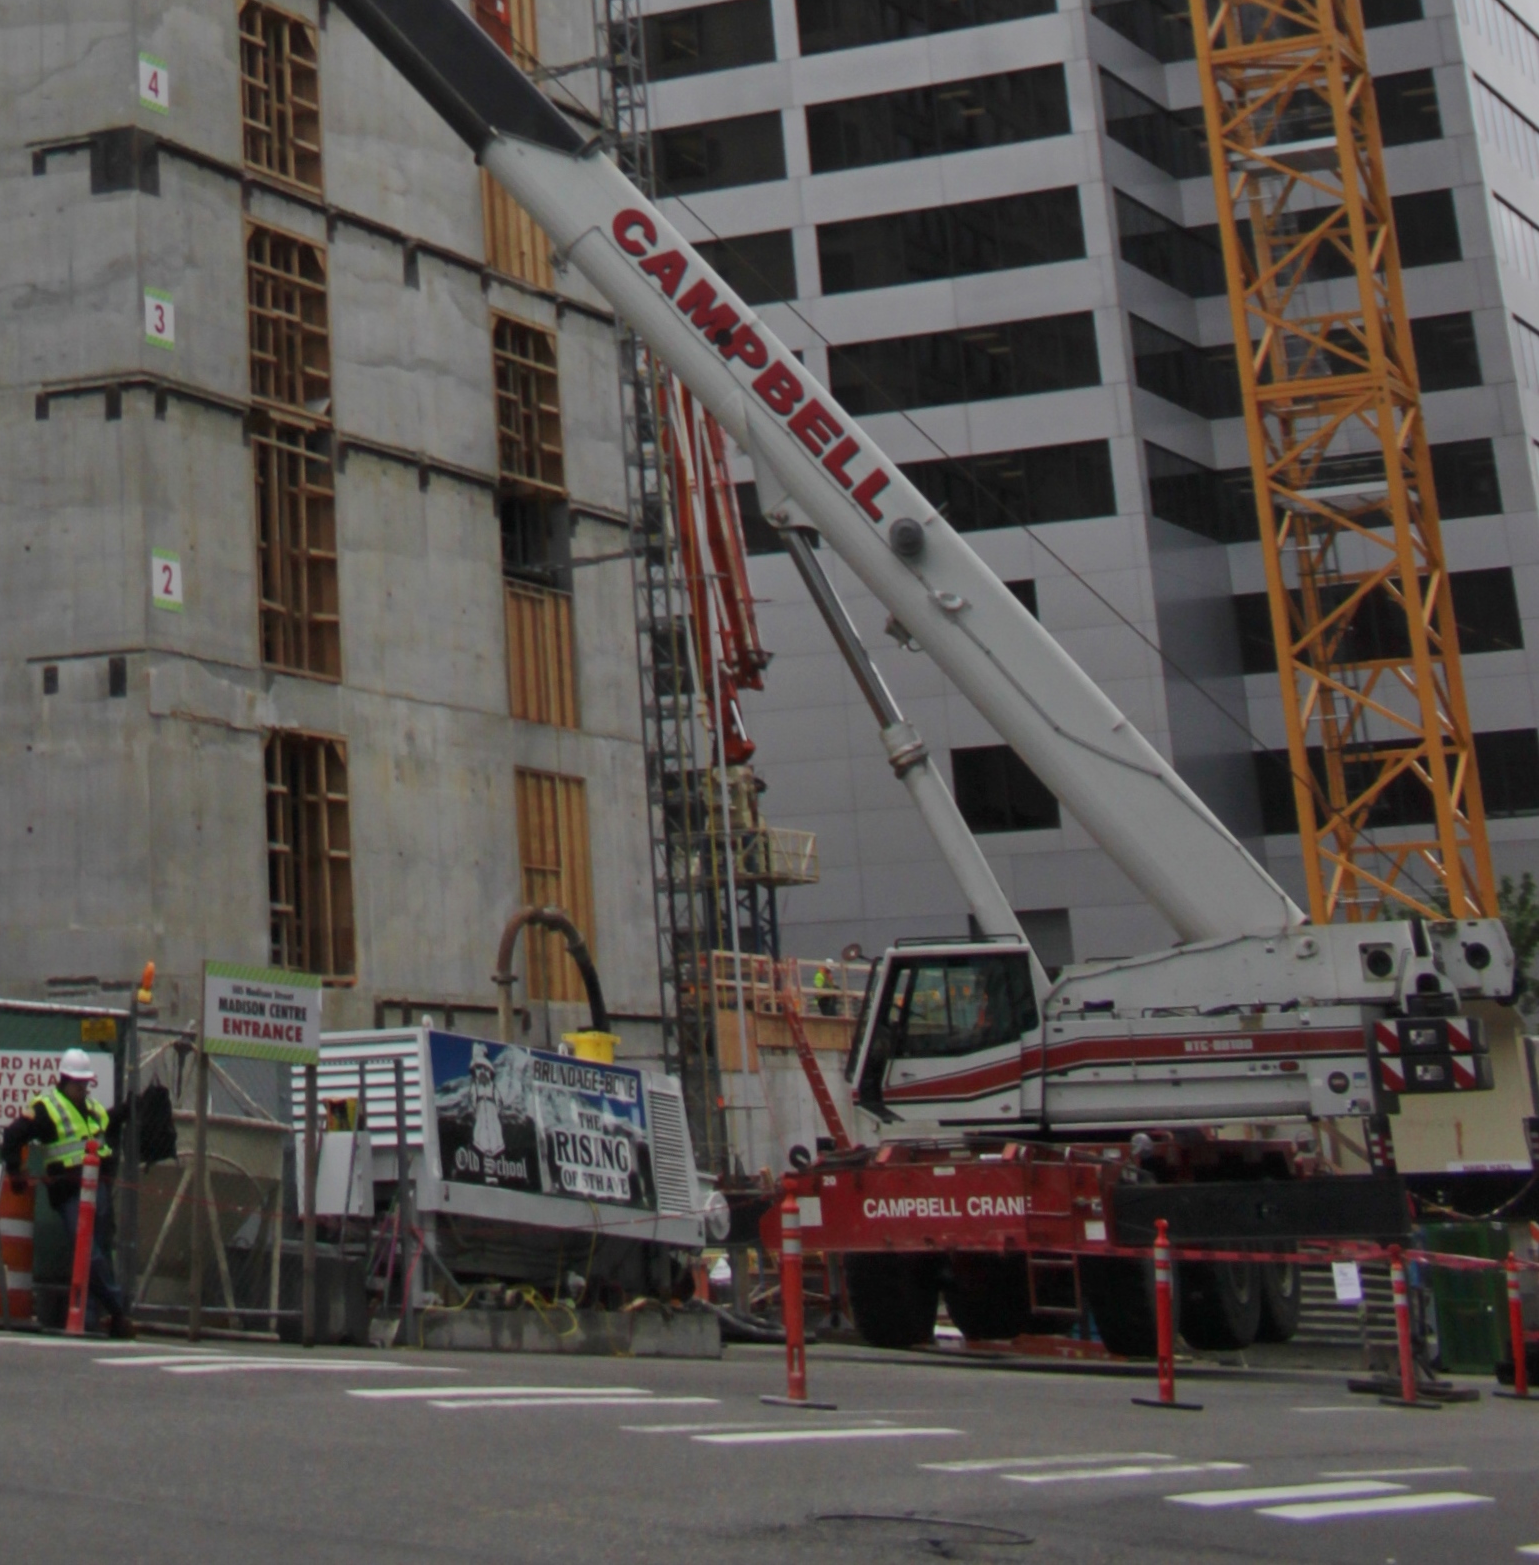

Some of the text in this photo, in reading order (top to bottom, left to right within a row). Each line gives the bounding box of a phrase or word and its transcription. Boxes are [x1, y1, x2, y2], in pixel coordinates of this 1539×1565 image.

[148, 70, 159, 98] 4
[154, 304, 165, 333] 3
[612, 208, 891, 523] CAMPBELL
[162, 564, 173, 594] 2
[218, 997, 307, 1022] MADISON CENTRE
[222, 1017, 304, 1043] ENTRANCE
[29, 1058, 61, 1072] HAT
[23, 1072, 98, 1089] GLAS
[577, 1111, 601, 1130] THE
[455, 1146, 528, 1180] Old School
[555, 1131, 630, 1173] RISING
[563, 1169, 577, 1187] OF
[607, 1177, 629, 1196] AVE
[822, 1175, 837, 1186] 20
[863, 1197, 963, 1218] CAMPBELL
